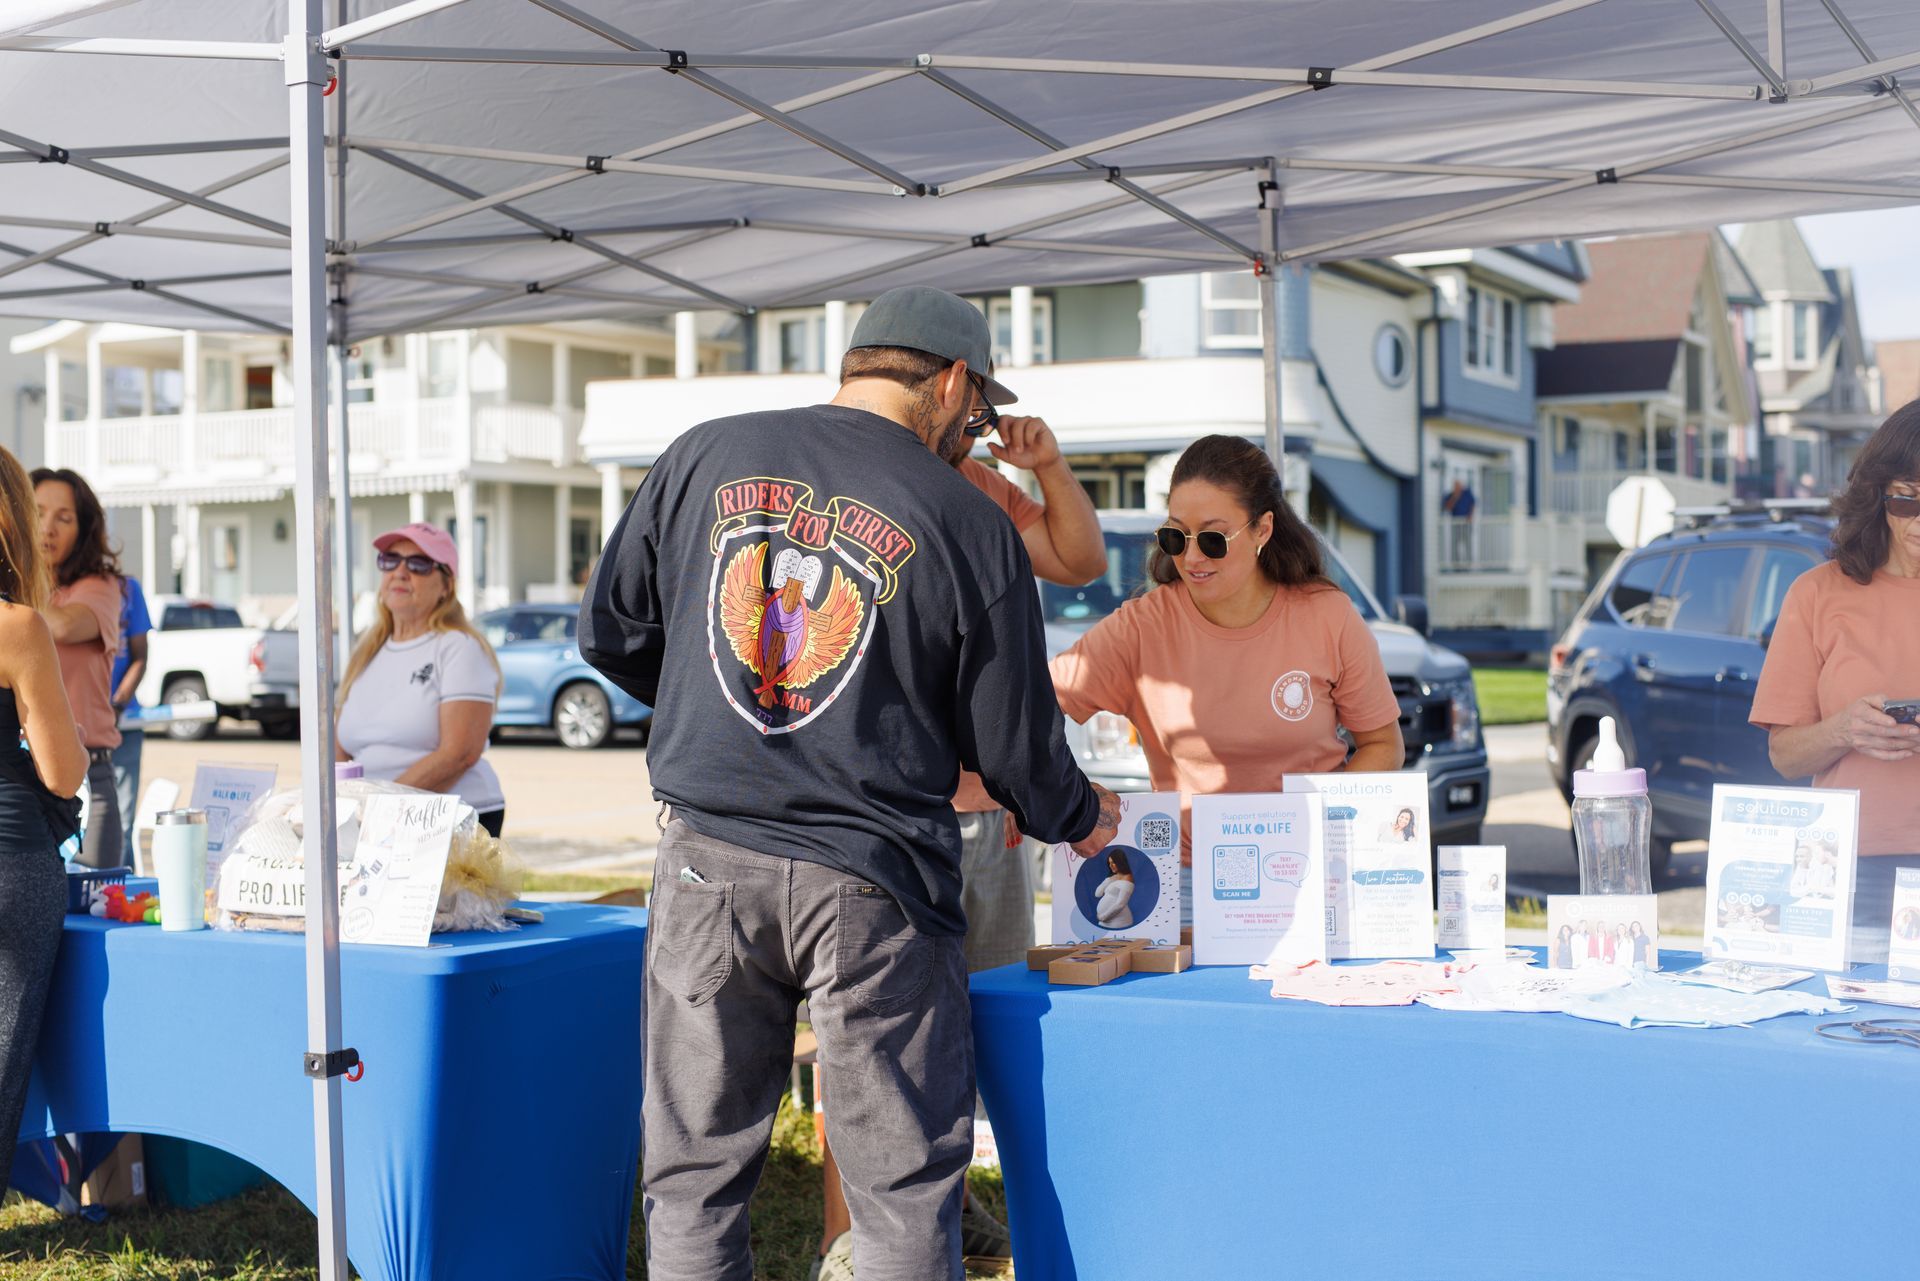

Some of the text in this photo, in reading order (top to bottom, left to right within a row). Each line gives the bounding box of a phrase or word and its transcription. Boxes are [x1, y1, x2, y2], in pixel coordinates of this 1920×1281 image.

[721, 482, 911, 563] RIDERS FOR CHRIST
[1283, 700, 1308, 715] BY GOD
[755, 708, 774, 724] 777
[1321, 782, 1393, 795] solutions
[405, 795, 447, 830] Raffle
[1221, 810, 1296, 821] Support solutions
[1736, 801, 1809, 817] solutions
[1222, 823, 1252, 835] WALK
[1267, 822, 1292, 834] LIFE
[1360, 871, 1379, 887] Two
